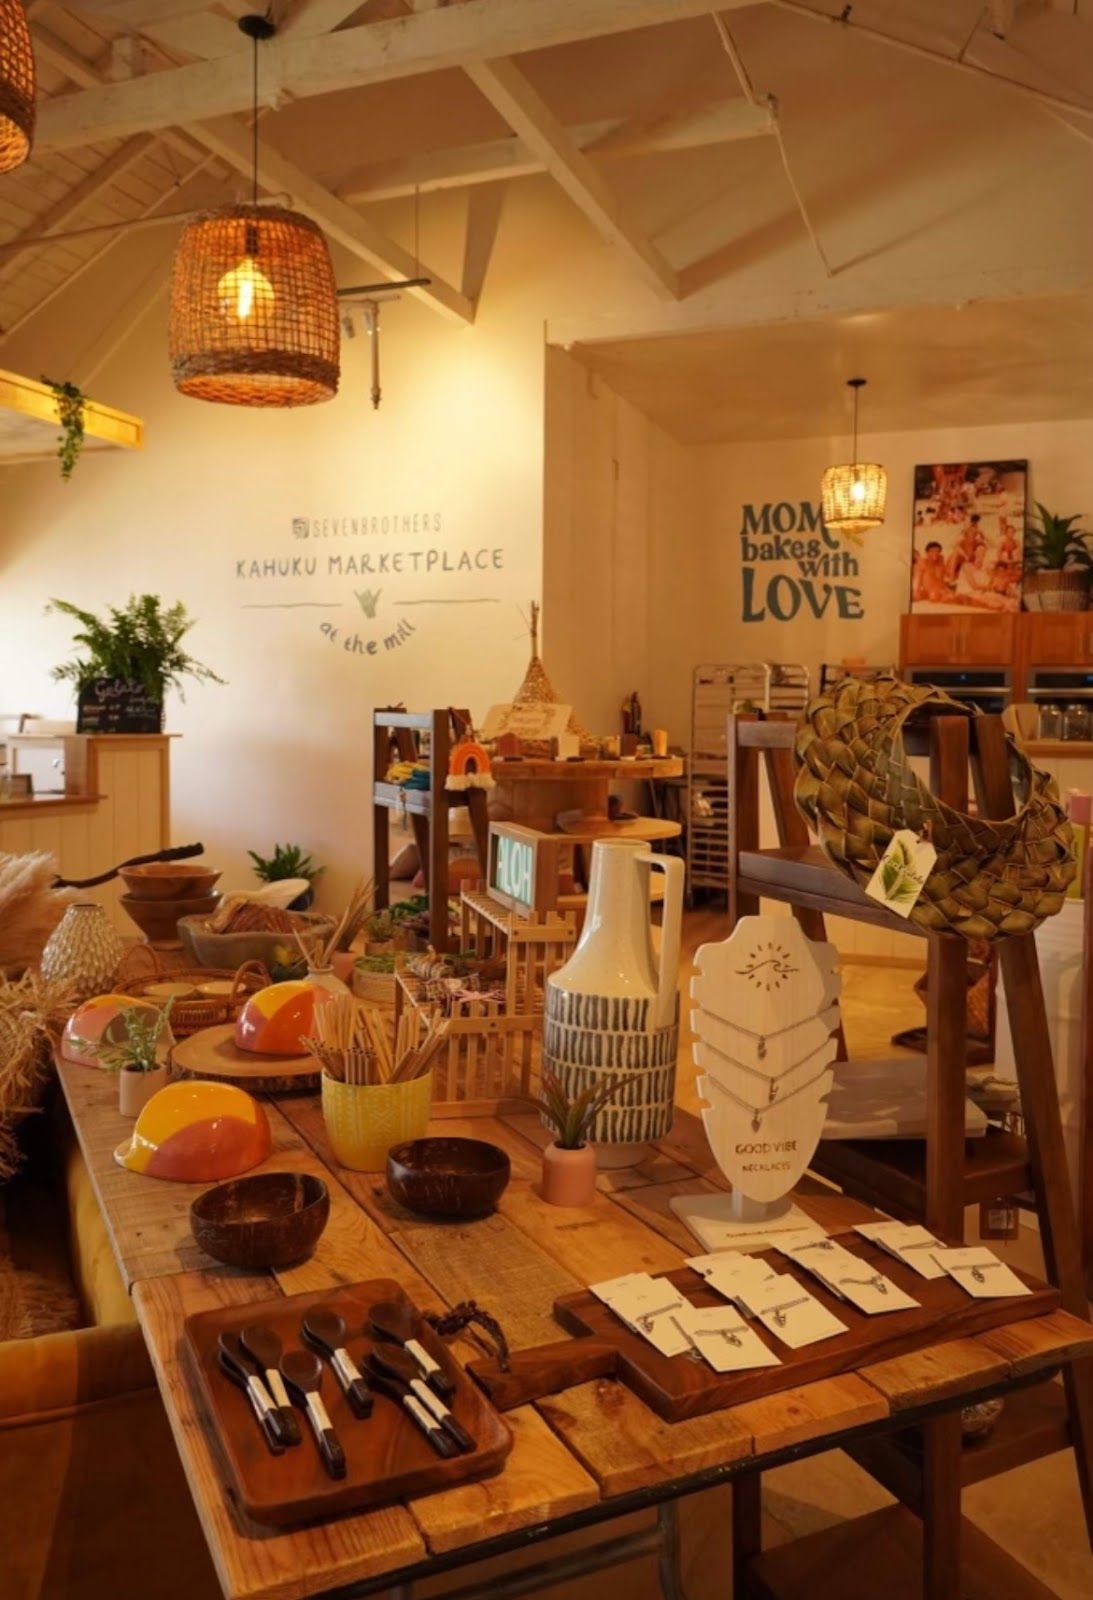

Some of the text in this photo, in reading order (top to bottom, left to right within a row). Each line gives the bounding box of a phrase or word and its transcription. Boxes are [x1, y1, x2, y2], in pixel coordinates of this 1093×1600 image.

[312, 512, 443, 539] SEVENBROTHERS
[740, 502, 840, 549] MOM
[741, 535, 822, 562] bakes
[235, 548, 505, 579] KAHUKU MARKETPLACE
[798, 551, 859, 578] with
[741, 567, 865, 623] LOVE
[319, 618, 416, 656] at the mill
[735, 1143, 771, 1155] GOOD
